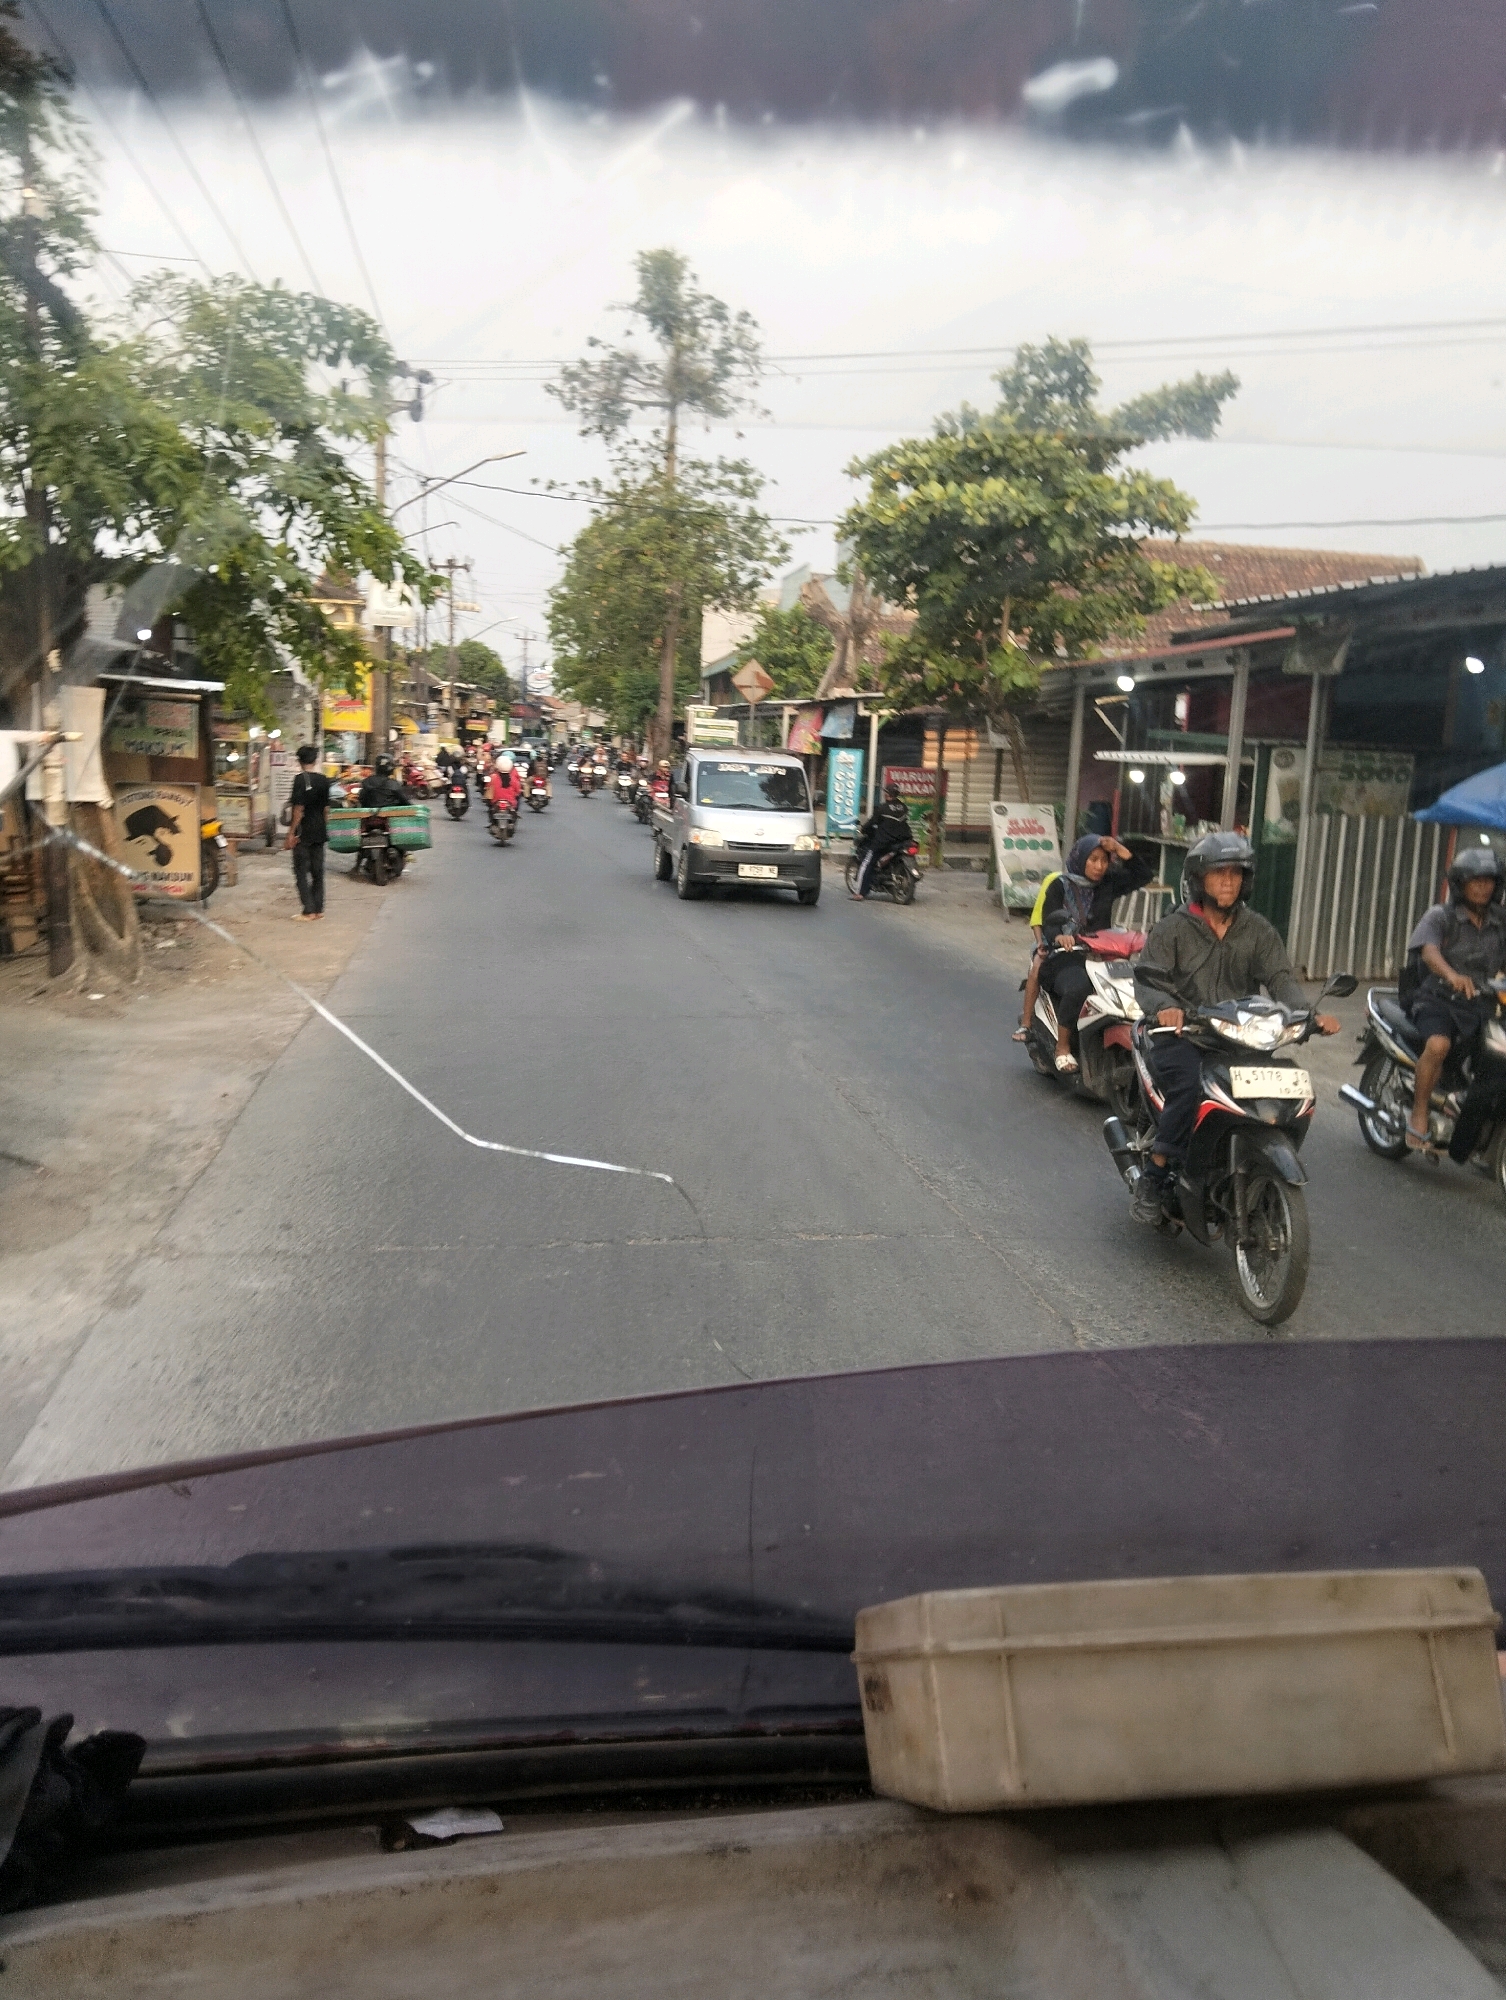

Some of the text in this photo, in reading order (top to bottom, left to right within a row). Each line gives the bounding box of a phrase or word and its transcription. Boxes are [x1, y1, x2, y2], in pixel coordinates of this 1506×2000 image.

[889, 770, 937, 784] WARUN
[1233, 1069, 1243, 1082] H
[1251, 1069, 1283, 1082] 5178
